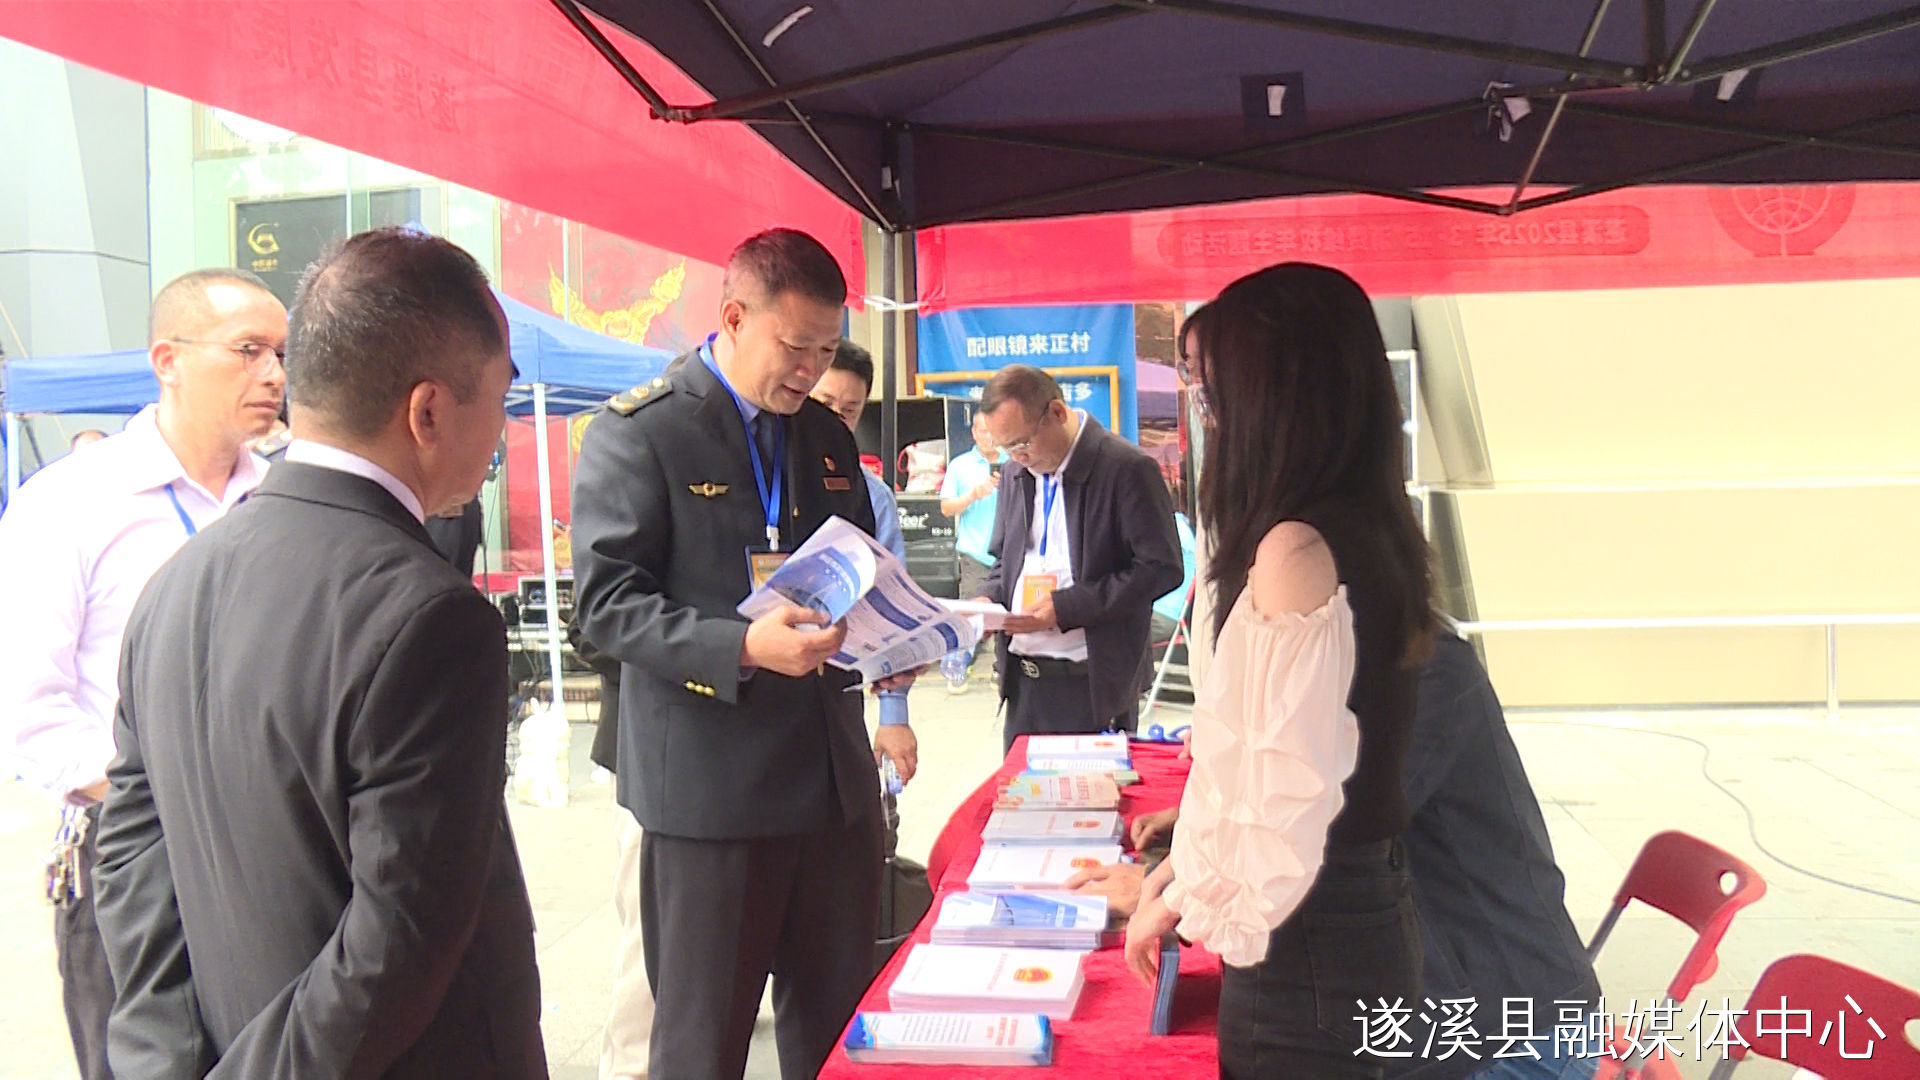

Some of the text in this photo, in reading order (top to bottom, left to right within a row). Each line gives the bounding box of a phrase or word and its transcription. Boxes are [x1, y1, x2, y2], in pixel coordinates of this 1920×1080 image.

[966, 331, 1091, 358] 配眼镜来正村
